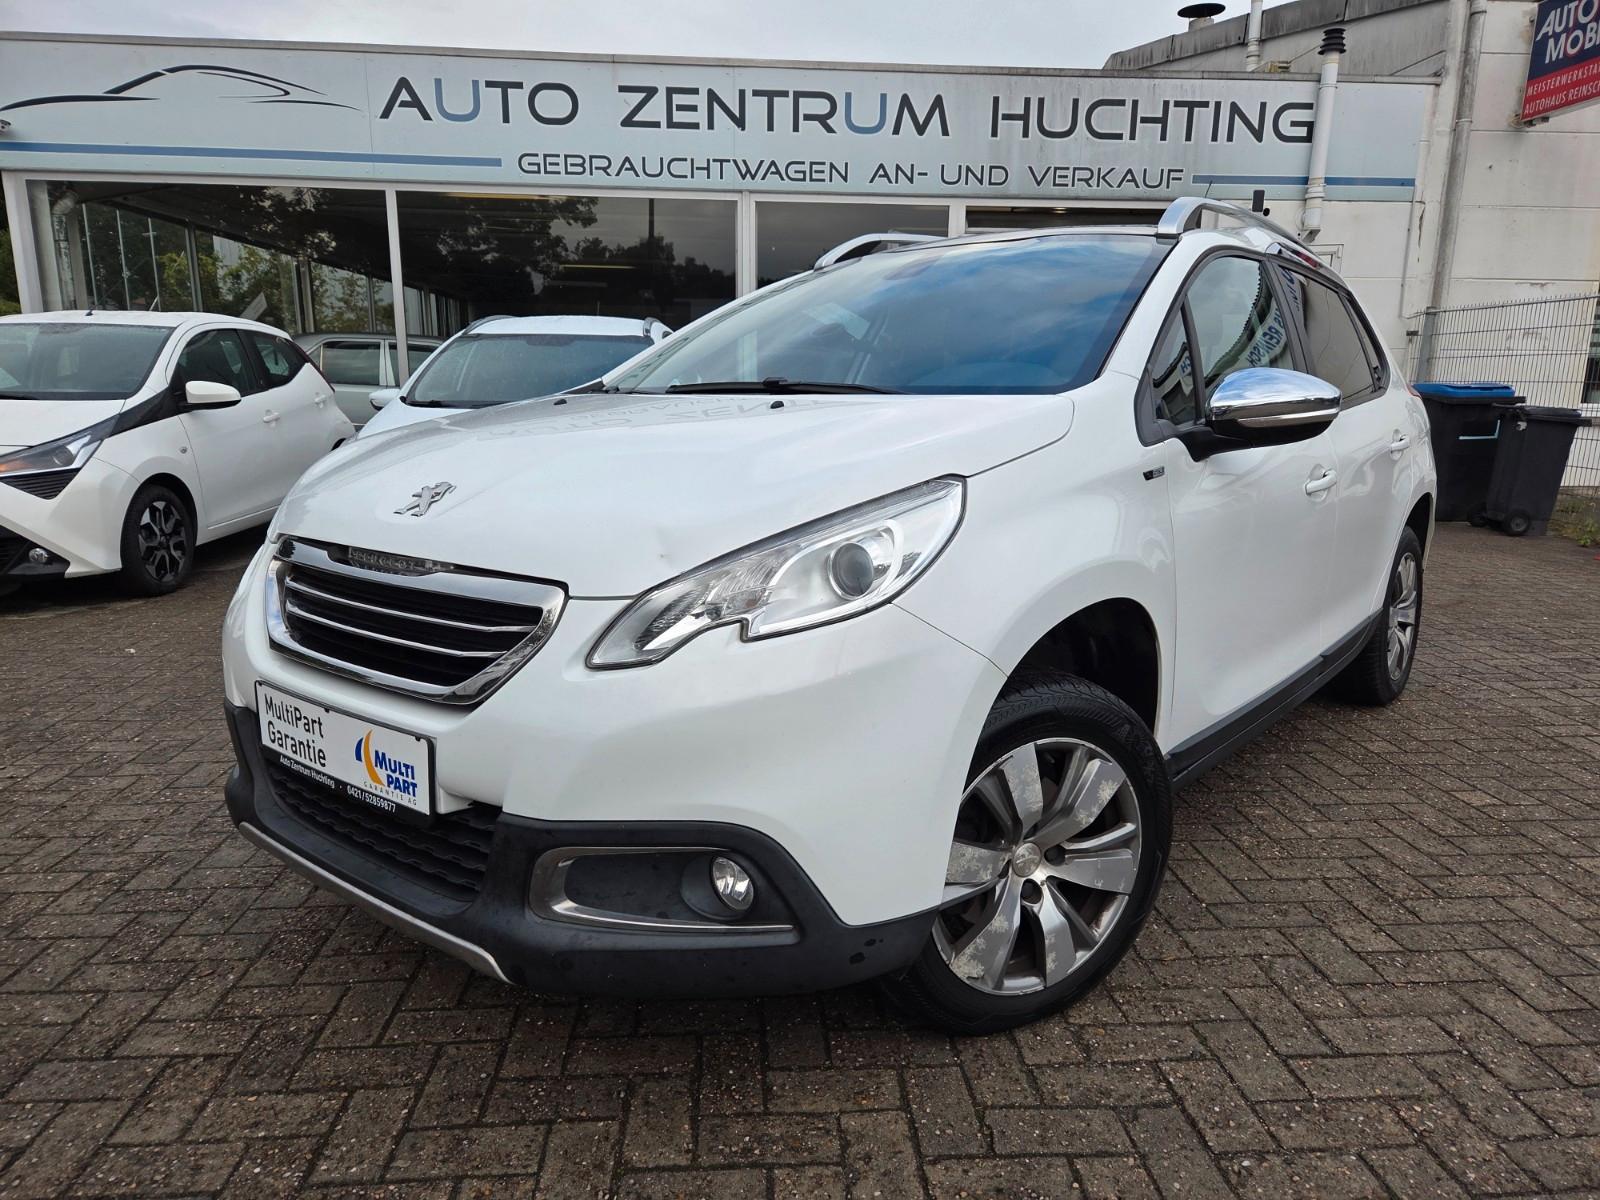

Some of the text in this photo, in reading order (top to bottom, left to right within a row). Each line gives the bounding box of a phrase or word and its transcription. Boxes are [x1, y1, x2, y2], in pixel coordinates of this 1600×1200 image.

[1536, 0, 1599, 41] AUTO
[1526, 62, 1600, 97] MEISTERWERKSTA
[379, 76, 1315, 144] AUTO ZENTRUM HUCHTING
[1524, 91, 1566, 114] AUTOHAUS
[518, 152, 1185, 190] GEBRAUCHTWAGEN AN- UND VERKAUF
[264, 693, 324, 739] MultiPart
[267, 720, 327, 768] Garantie
[280, 754, 291, 767] Auto
[291, 759, 312, 777] Zentrum
[311, 769, 335, 789] Huchting
[375, 750, 415, 780] MULTI
[363, 781, 417, 806] GARANTIE AG
[386, 773, 418, 798] PART
